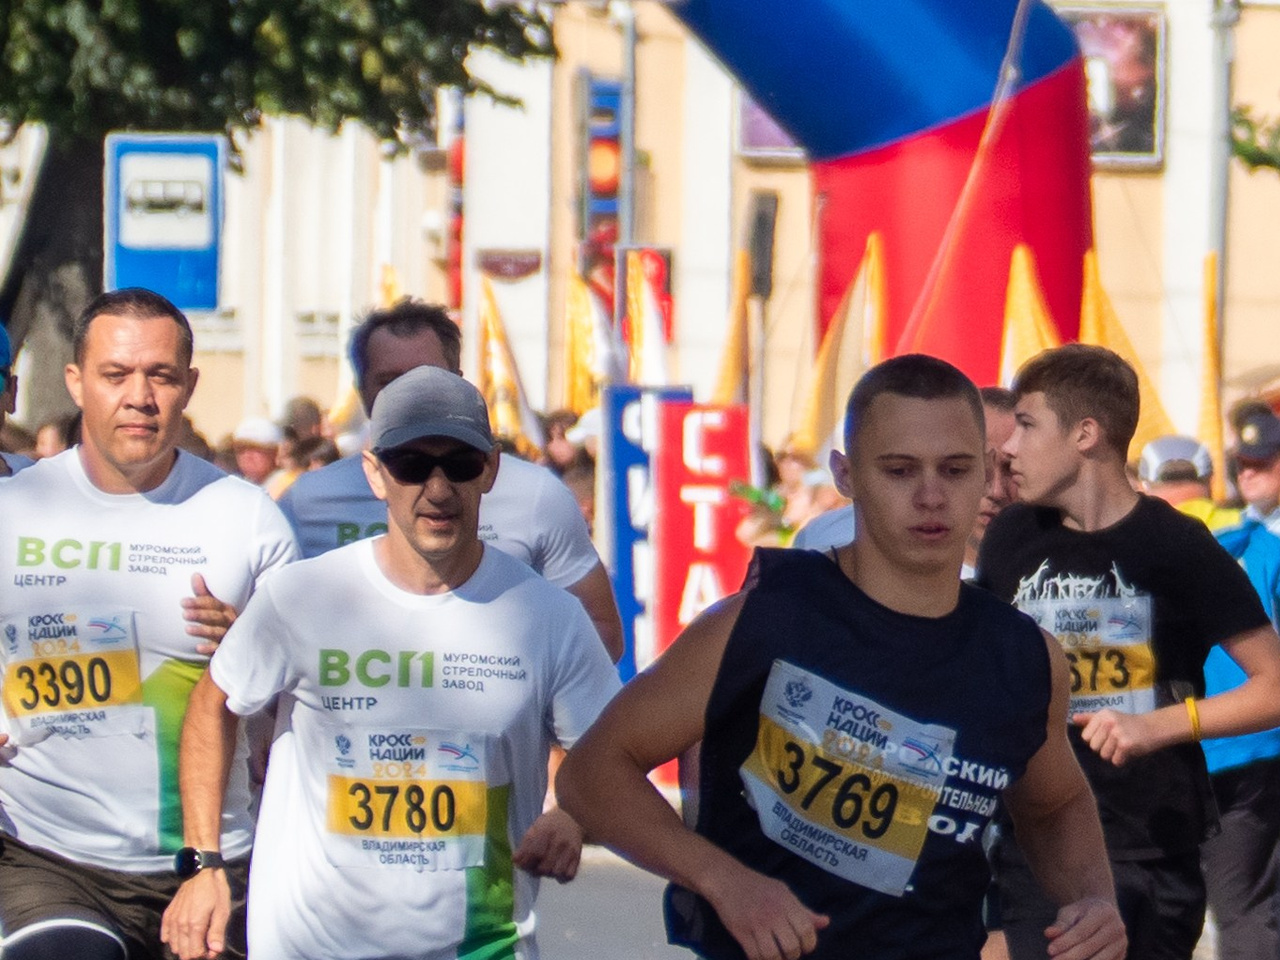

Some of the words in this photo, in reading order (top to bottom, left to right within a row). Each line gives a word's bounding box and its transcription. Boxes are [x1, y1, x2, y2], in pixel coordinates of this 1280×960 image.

[129, 543, 201, 554] МУРОМСКИЙ
[128, 554, 207, 565] СТРЕЛОЧНЫЙ
[128, 565, 167, 576] ЗАВОД
[14, 574, 67, 587] ЦЕНТР
[28, 613, 64, 627] КРОСС
[1054, 621, 1098, 633] НАЦИИ
[28, 625, 77, 641] НАЦИИ
[443, 653, 521, 667] МУРОМСКИЙ
[442, 666, 527, 681] СТРЕЛОЧНЫЙ
[16, 657, 112, 711] 3390
[442, 679, 484, 692] ЗАВОД
[321, 696, 378, 711] ЦЕНТР
[833, 696, 880, 727] КРОСС
[826, 712, 888, 749] НАЦИИ
[368, 734, 412, 747] КРОСС
[369, 748, 425, 762] НАЦИИ
[372, 762, 427, 778] 2024
[777, 741, 899, 840] 3769
[348, 782, 456, 833] 3780
[772, 801, 868, 861] ВЛАДИМИРСКАЯ
[361, 840, 446, 851] ВЛАДИМИРСКАЯ
[780, 829, 839, 868] ОБЛАСТЬ
[379, 854, 429, 865] ОБЛАСТЬ
